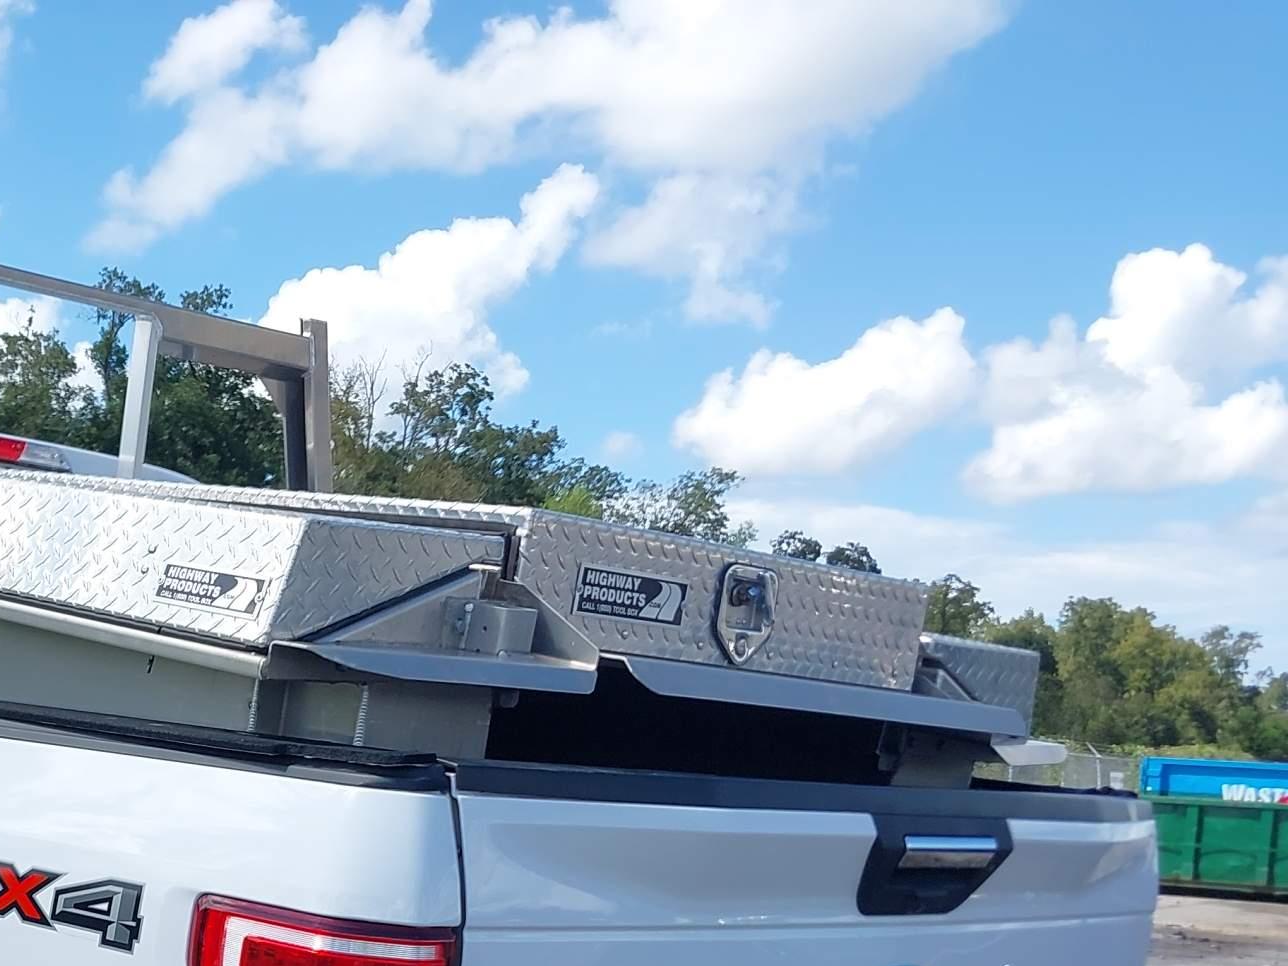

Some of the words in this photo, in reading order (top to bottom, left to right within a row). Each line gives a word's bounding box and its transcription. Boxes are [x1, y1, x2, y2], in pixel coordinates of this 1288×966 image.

[168, 566, 219, 585] HIGHWAY
[586, 570, 642, 591] HIGHWAY
[164, 578, 222, 597] PRODUCTS
[583, 586, 647, 607] PRODUCTS
[582, 601, 595, 610] CALL
